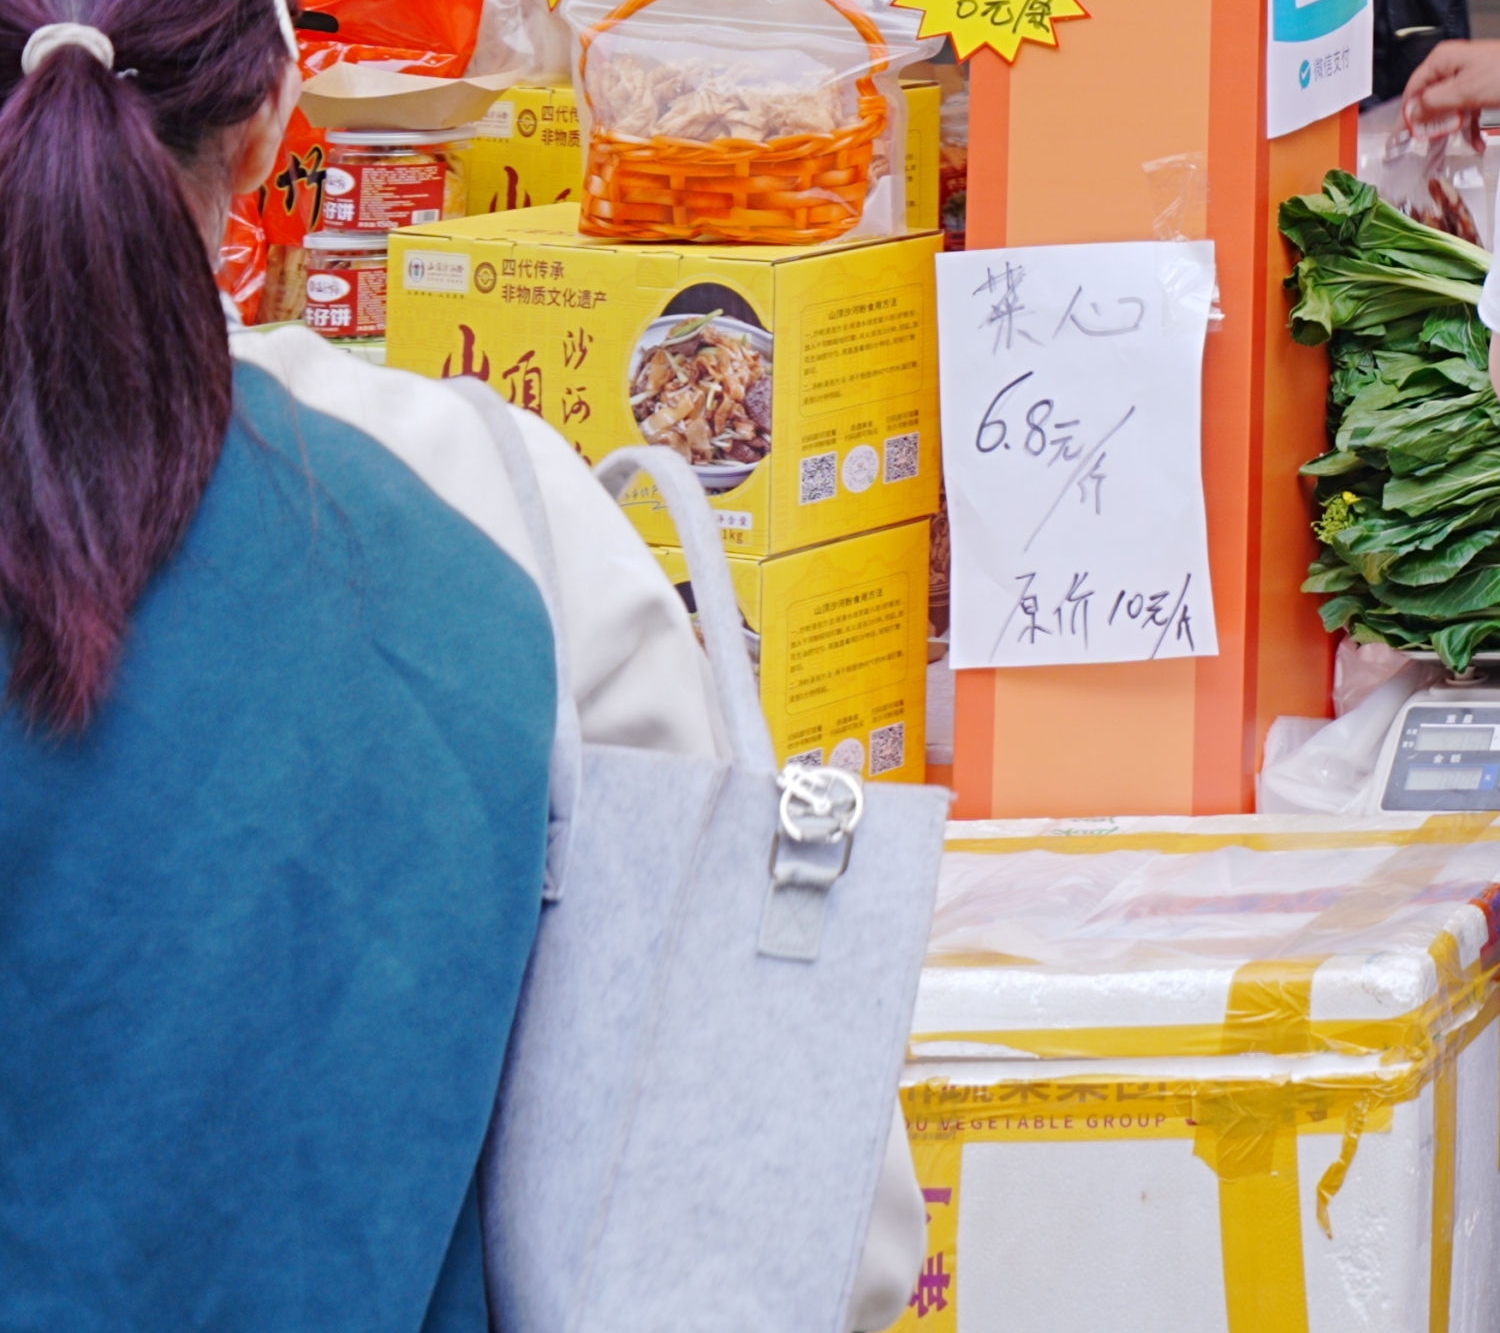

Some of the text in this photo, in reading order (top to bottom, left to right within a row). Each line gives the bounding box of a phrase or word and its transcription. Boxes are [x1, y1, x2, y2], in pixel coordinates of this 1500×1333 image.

[1313, 46, 1351, 83] 微信支付
[323, 202, 356, 221] 仔饼
[502, 259, 565, 280] 四代传承
[502, 287, 607, 310] 非物质文化遗产
[828, 297, 898, 320] 山顶沙河粉食用方法
[973, 261, 1145, 354] 菜心
[716, 514, 748, 527] 净含量
[722, 528, 744, 544] 1kg
[814, 588, 884, 616] 山顶沙河粉食用方法
[990, 571, 1094, 662] 原价
[940, 1114, 1075, 1131] VEGETABLE
[1086, 1112, 1168, 1129] GROUP
